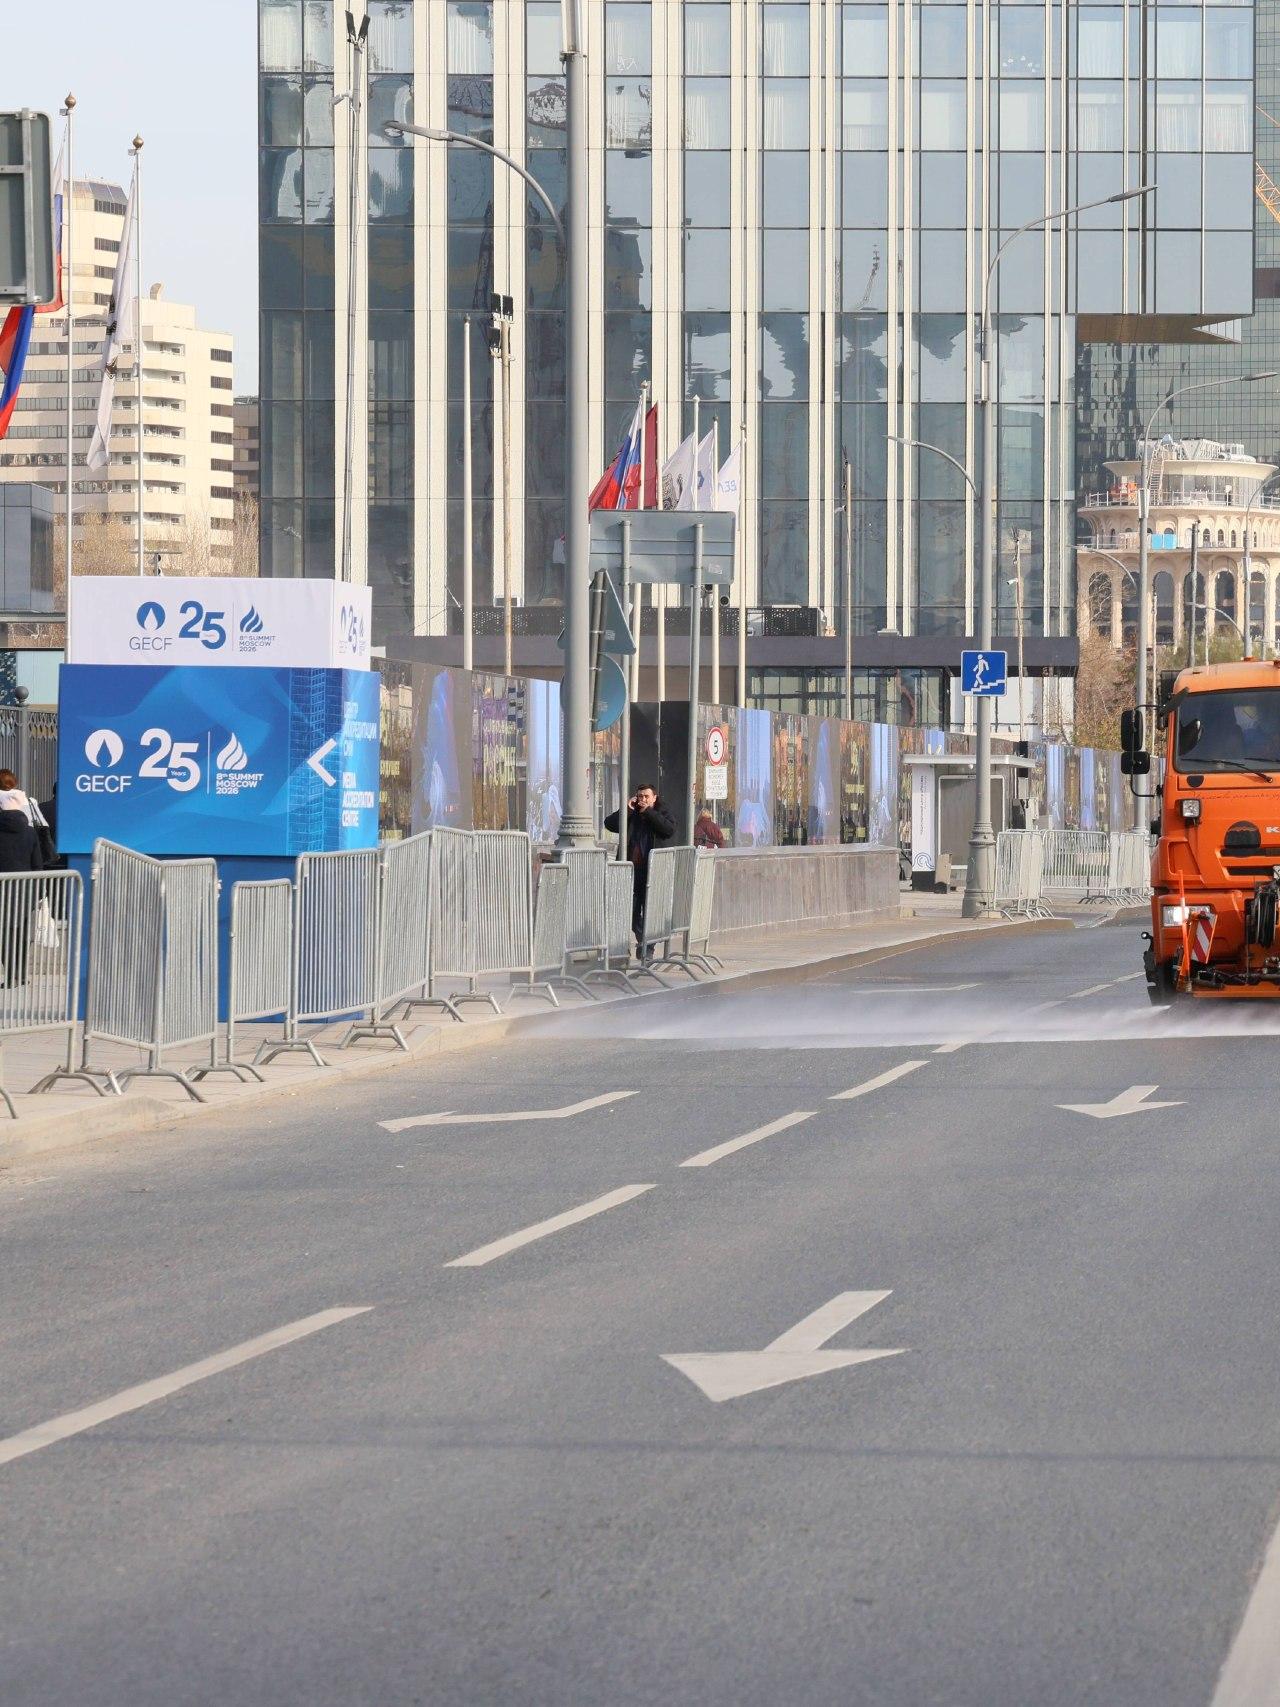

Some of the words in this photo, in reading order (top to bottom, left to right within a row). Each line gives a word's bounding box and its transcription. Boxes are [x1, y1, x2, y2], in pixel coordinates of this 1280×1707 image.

[178, 600, 227, 650] 25
[129, 636, 173, 651] GECF
[713, 740, 719, 755] 5
[138, 728, 201, 792] 25
[75, 774, 132, 793] GECF
[216, 780, 258, 788] MOSCOW
[228, 773, 264, 781] SUMMIT
[216, 787, 239, 795] 2026
